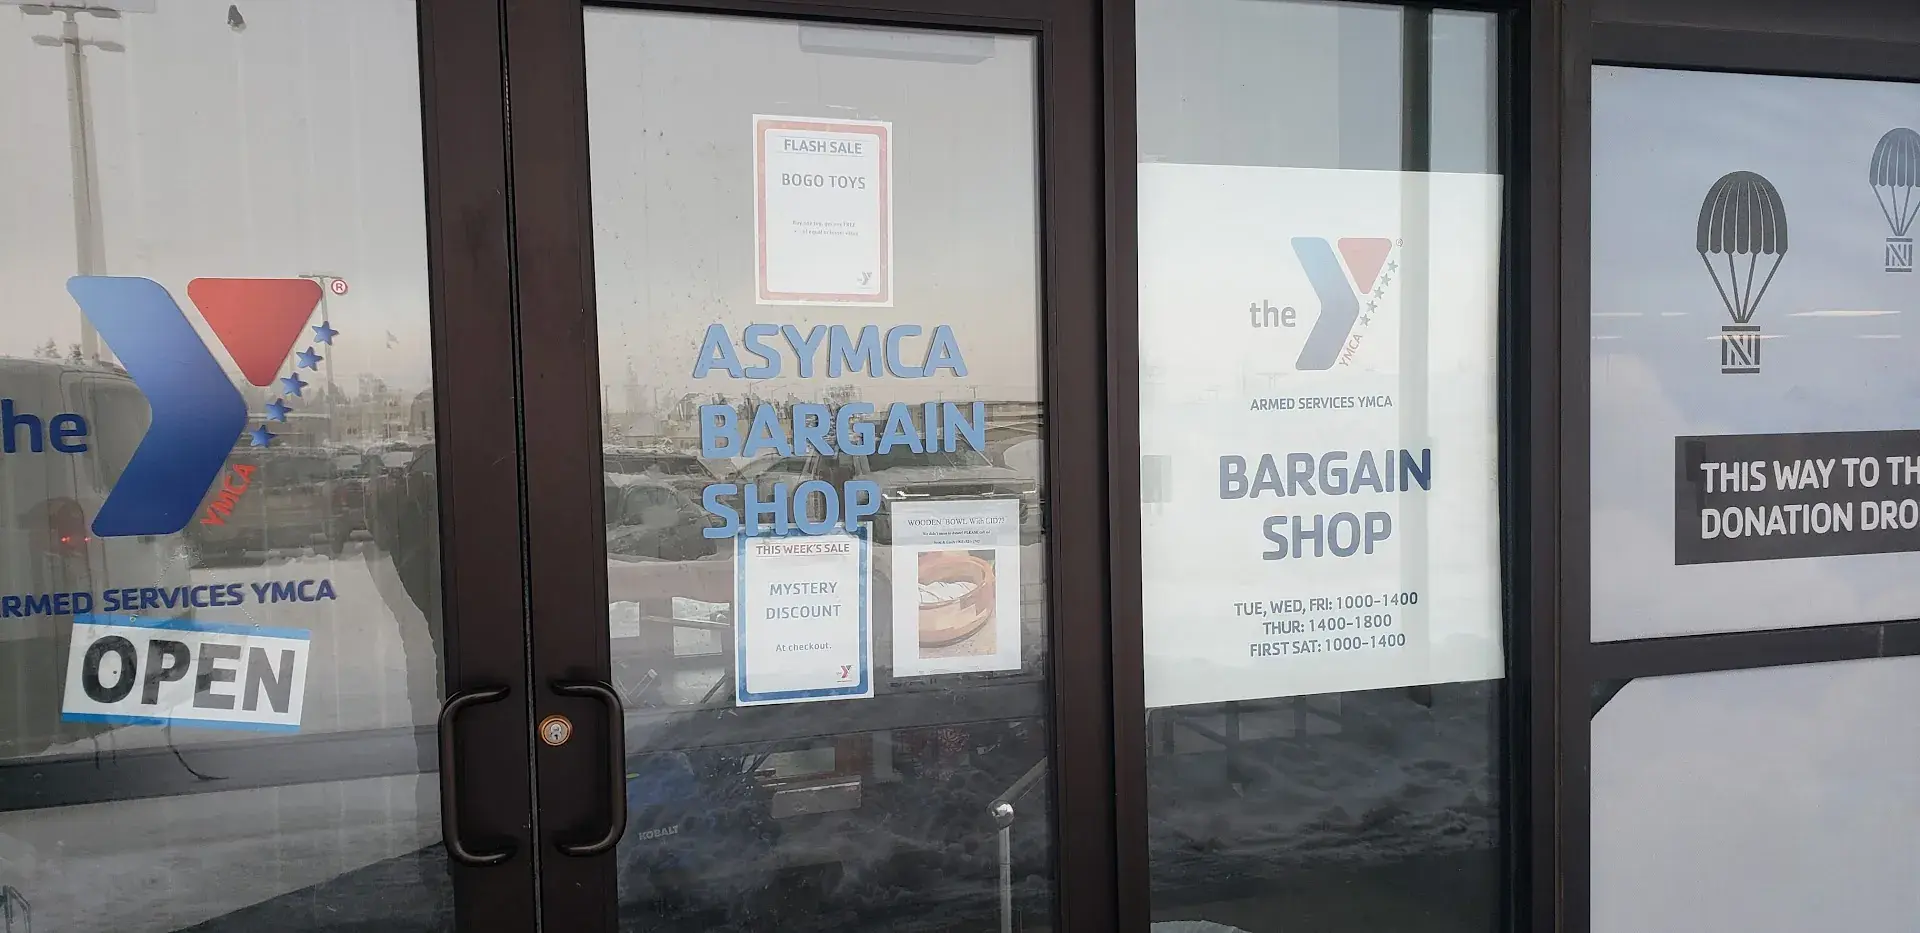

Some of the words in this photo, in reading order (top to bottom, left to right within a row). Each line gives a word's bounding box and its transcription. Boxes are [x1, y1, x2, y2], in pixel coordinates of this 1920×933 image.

[784, 138, 826, 153] FLASH
[829, 140, 863, 155] SALE
[781, 172, 824, 188] BOGO
[828, 174, 866, 190] TOYS
[1249, 299, 1297, 328] the
[692, 323, 969, 380] ASYMCA
[1338, 332, 1363, 368] YMCA
[1250, 397, 1295, 412] ARMED
[1298, 395, 1355, 411] SERVICES
[1358, 394, 1393, 408] YMCA
[700, 400, 986, 459] BARGAIN
[1219, 448, 1432, 500] BARGAIN
[1700, 460, 1767, 494] THIS
[1773, 458, 1836, 492] WAY
[1841, 456, 1880, 489] TO
[199, 463, 257, 529] YMCA
[702, 480, 881, 539] SHOP
[907, 518, 942, 527] WOODEN
[945, 517, 967, 526] BOWL
[1701, 502, 1853, 540] DONATION
[1860, 498, 1919, 532] DRO
[755, 545, 781, 555] THIS
[783, 543, 822, 554] WEEK'S
[824, 543, 850, 553] SALE
[1262, 511, 1392, 561] SHOP
[0, 591, 94, 620] RMED
[103, 583, 244, 612] SERVICES
[249, 578, 338, 604] YMCA
[769, 581, 838, 596] MYSTERY
[765, 604, 842, 620] DISCOUNT
[1233, 601, 1267, 617] TUE,
[1269, 599, 1306, 615] WED,
[1309, 597, 1333, 612] FRI:
[1336, 591, 1419, 610] 1000-1400
[1262, 620, 1305, 635] THUR:
[1309, 614, 1392, 632] 1400-1800
[775, 643, 786, 652] At
[788, 641, 832, 651] checkout.
[1250, 641, 1290, 657] FIRST
[1292, 640, 1322, 655] SAT:
[1325, 633, 1406, 652] 1000-1400
[81, 635, 296, 715] OPEN
[638, 824, 679, 841] KOBALT
